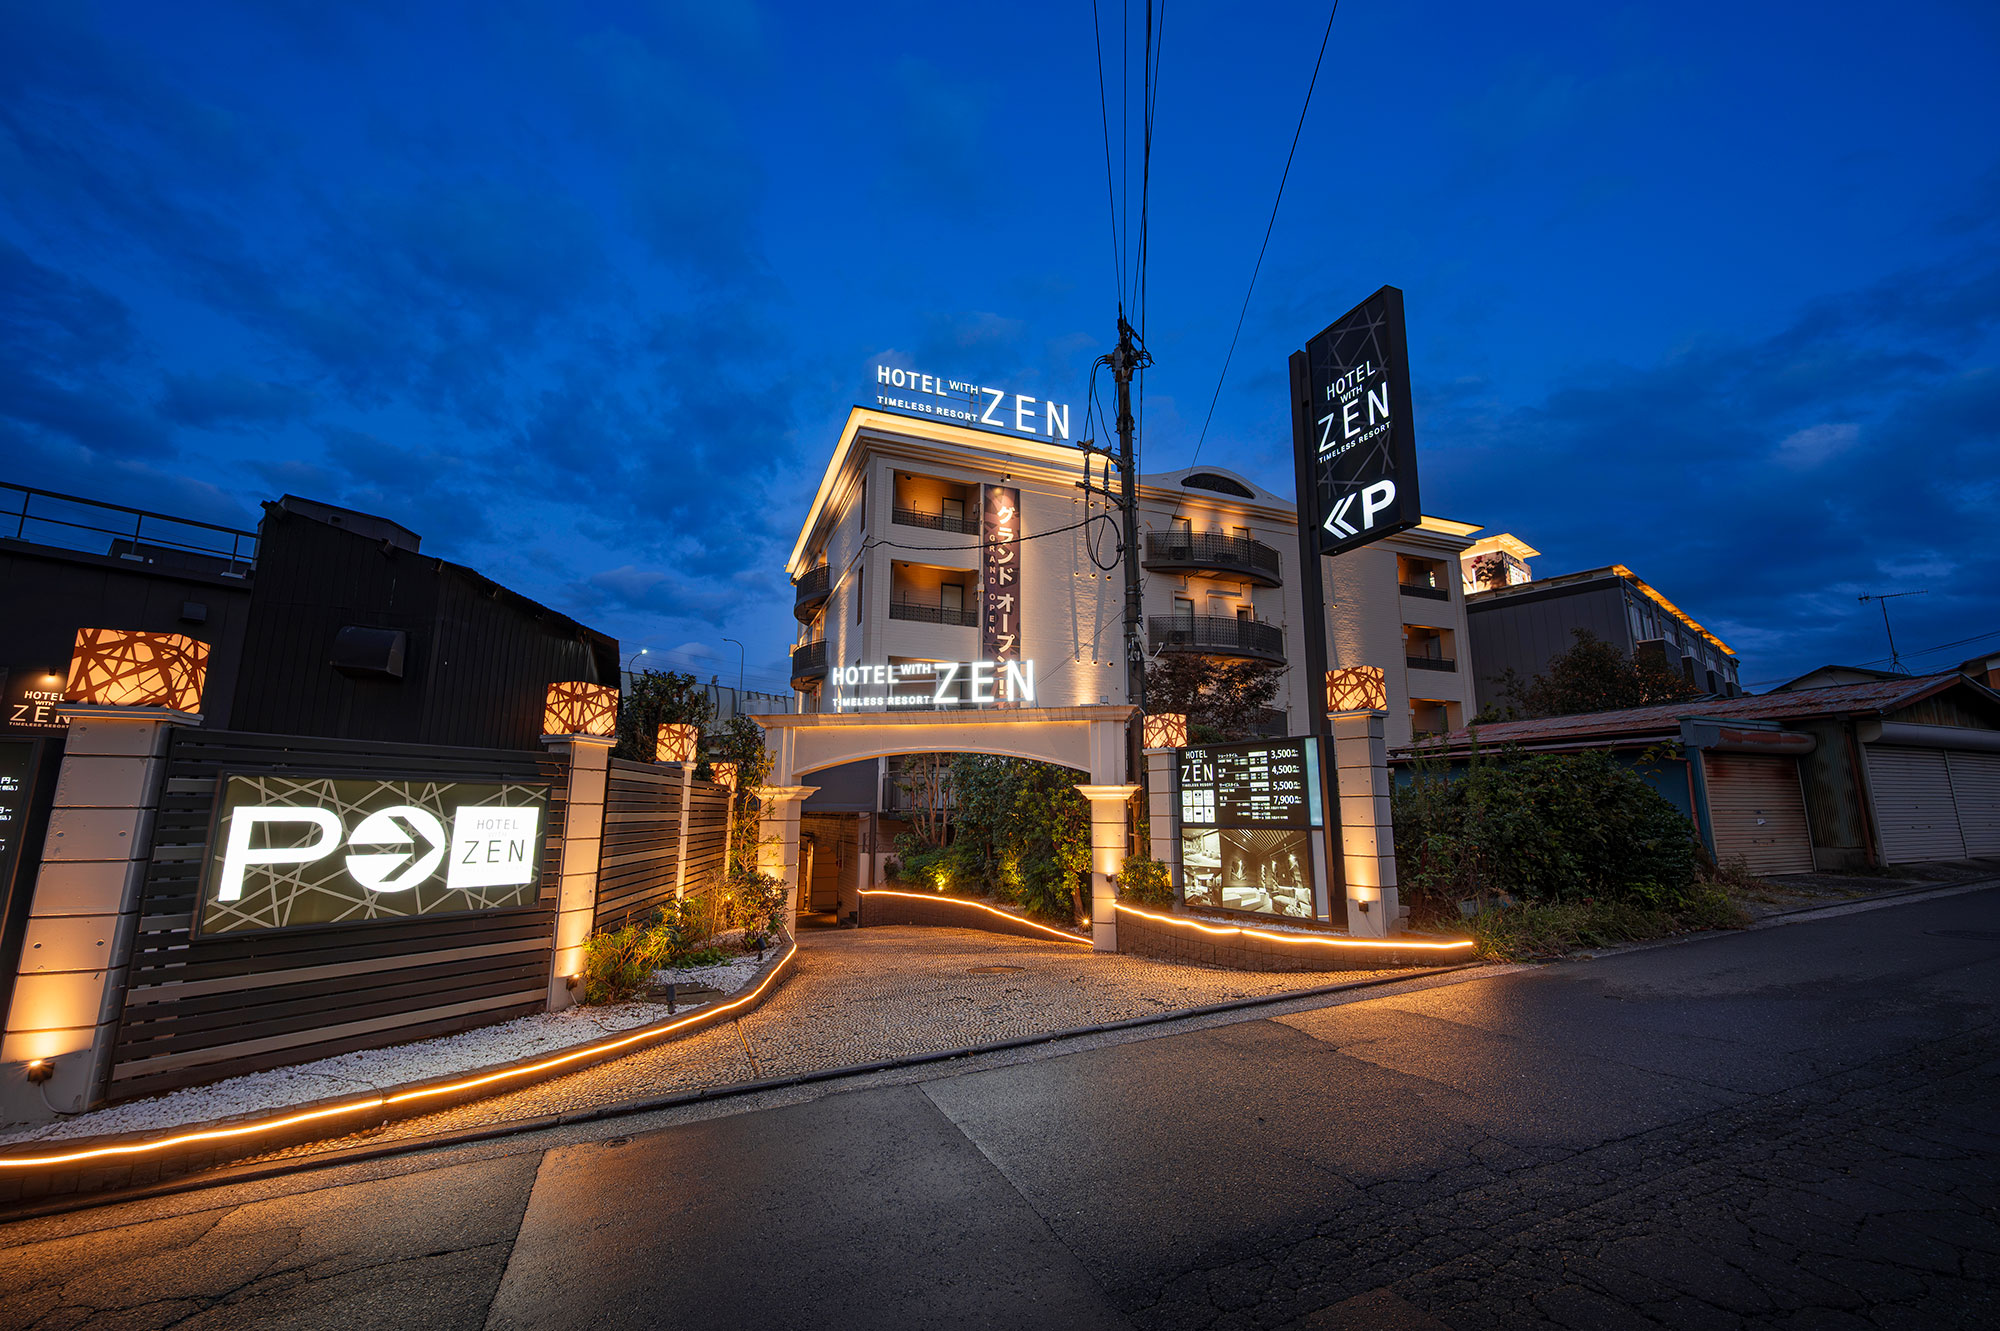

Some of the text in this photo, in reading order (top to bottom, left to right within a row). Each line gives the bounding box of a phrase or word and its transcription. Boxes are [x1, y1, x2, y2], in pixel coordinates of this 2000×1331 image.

[1326, 360, 1376, 401] HOTEL
[1340, 384, 1363, 404] WITH
[877, 365, 1069, 440] HOTEL WITH ZEN
[877, 395, 978, 422] TIMELESS RESORT
[1318, 381, 1390, 453] ZEN
[1318, 421, 1391, 464] TIMELESS RESORT
[1361, 479, 1396, 530] P
[988, 534, 996, 634] GRAND OPEN
[24, 690, 65, 702] HOTEL
[832, 659, 1034, 704] HOTEL WITH ZEN
[833, 695, 930, 707] TIMELESS RESORT
[1185, 750, 1208, 759] HOTEL
[1181, 763, 1213, 782] ZEN
[476, 818, 520, 830] HOTEL
[218, 806, 343, 902] P
[461, 839, 525, 865] ZEN
